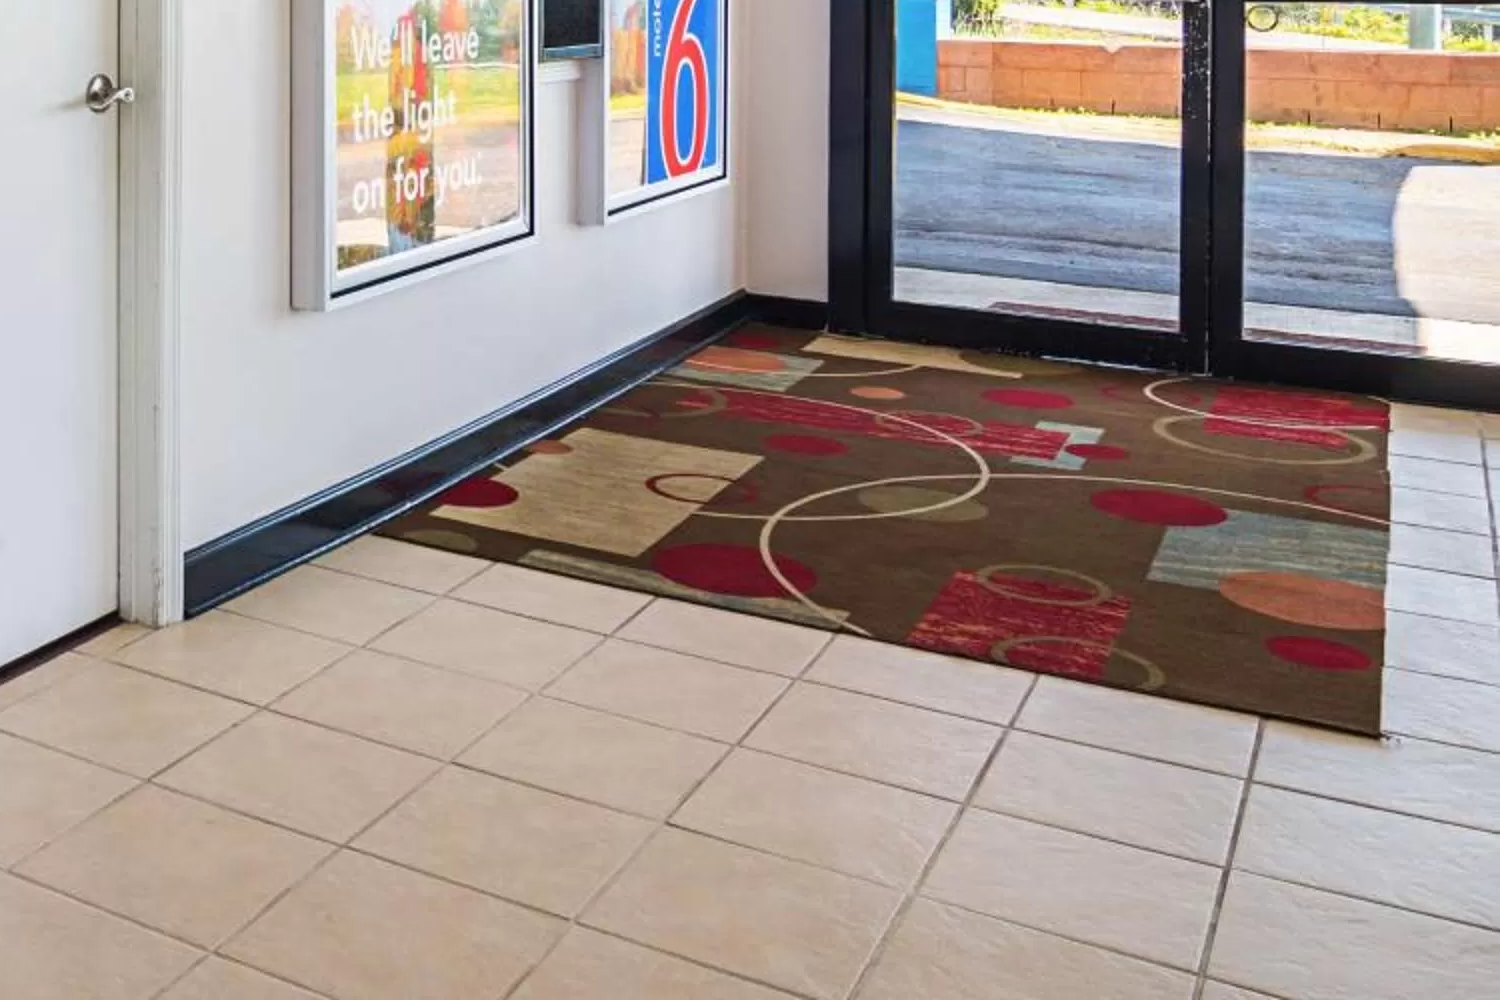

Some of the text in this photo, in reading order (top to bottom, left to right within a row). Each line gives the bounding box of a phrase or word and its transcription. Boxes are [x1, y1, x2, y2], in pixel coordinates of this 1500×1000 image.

[350, 20, 479, 70] We'll leave
[354, 82, 457, 143] the light
[353, 176, 385, 213] on
[394, 157, 429, 204] for
